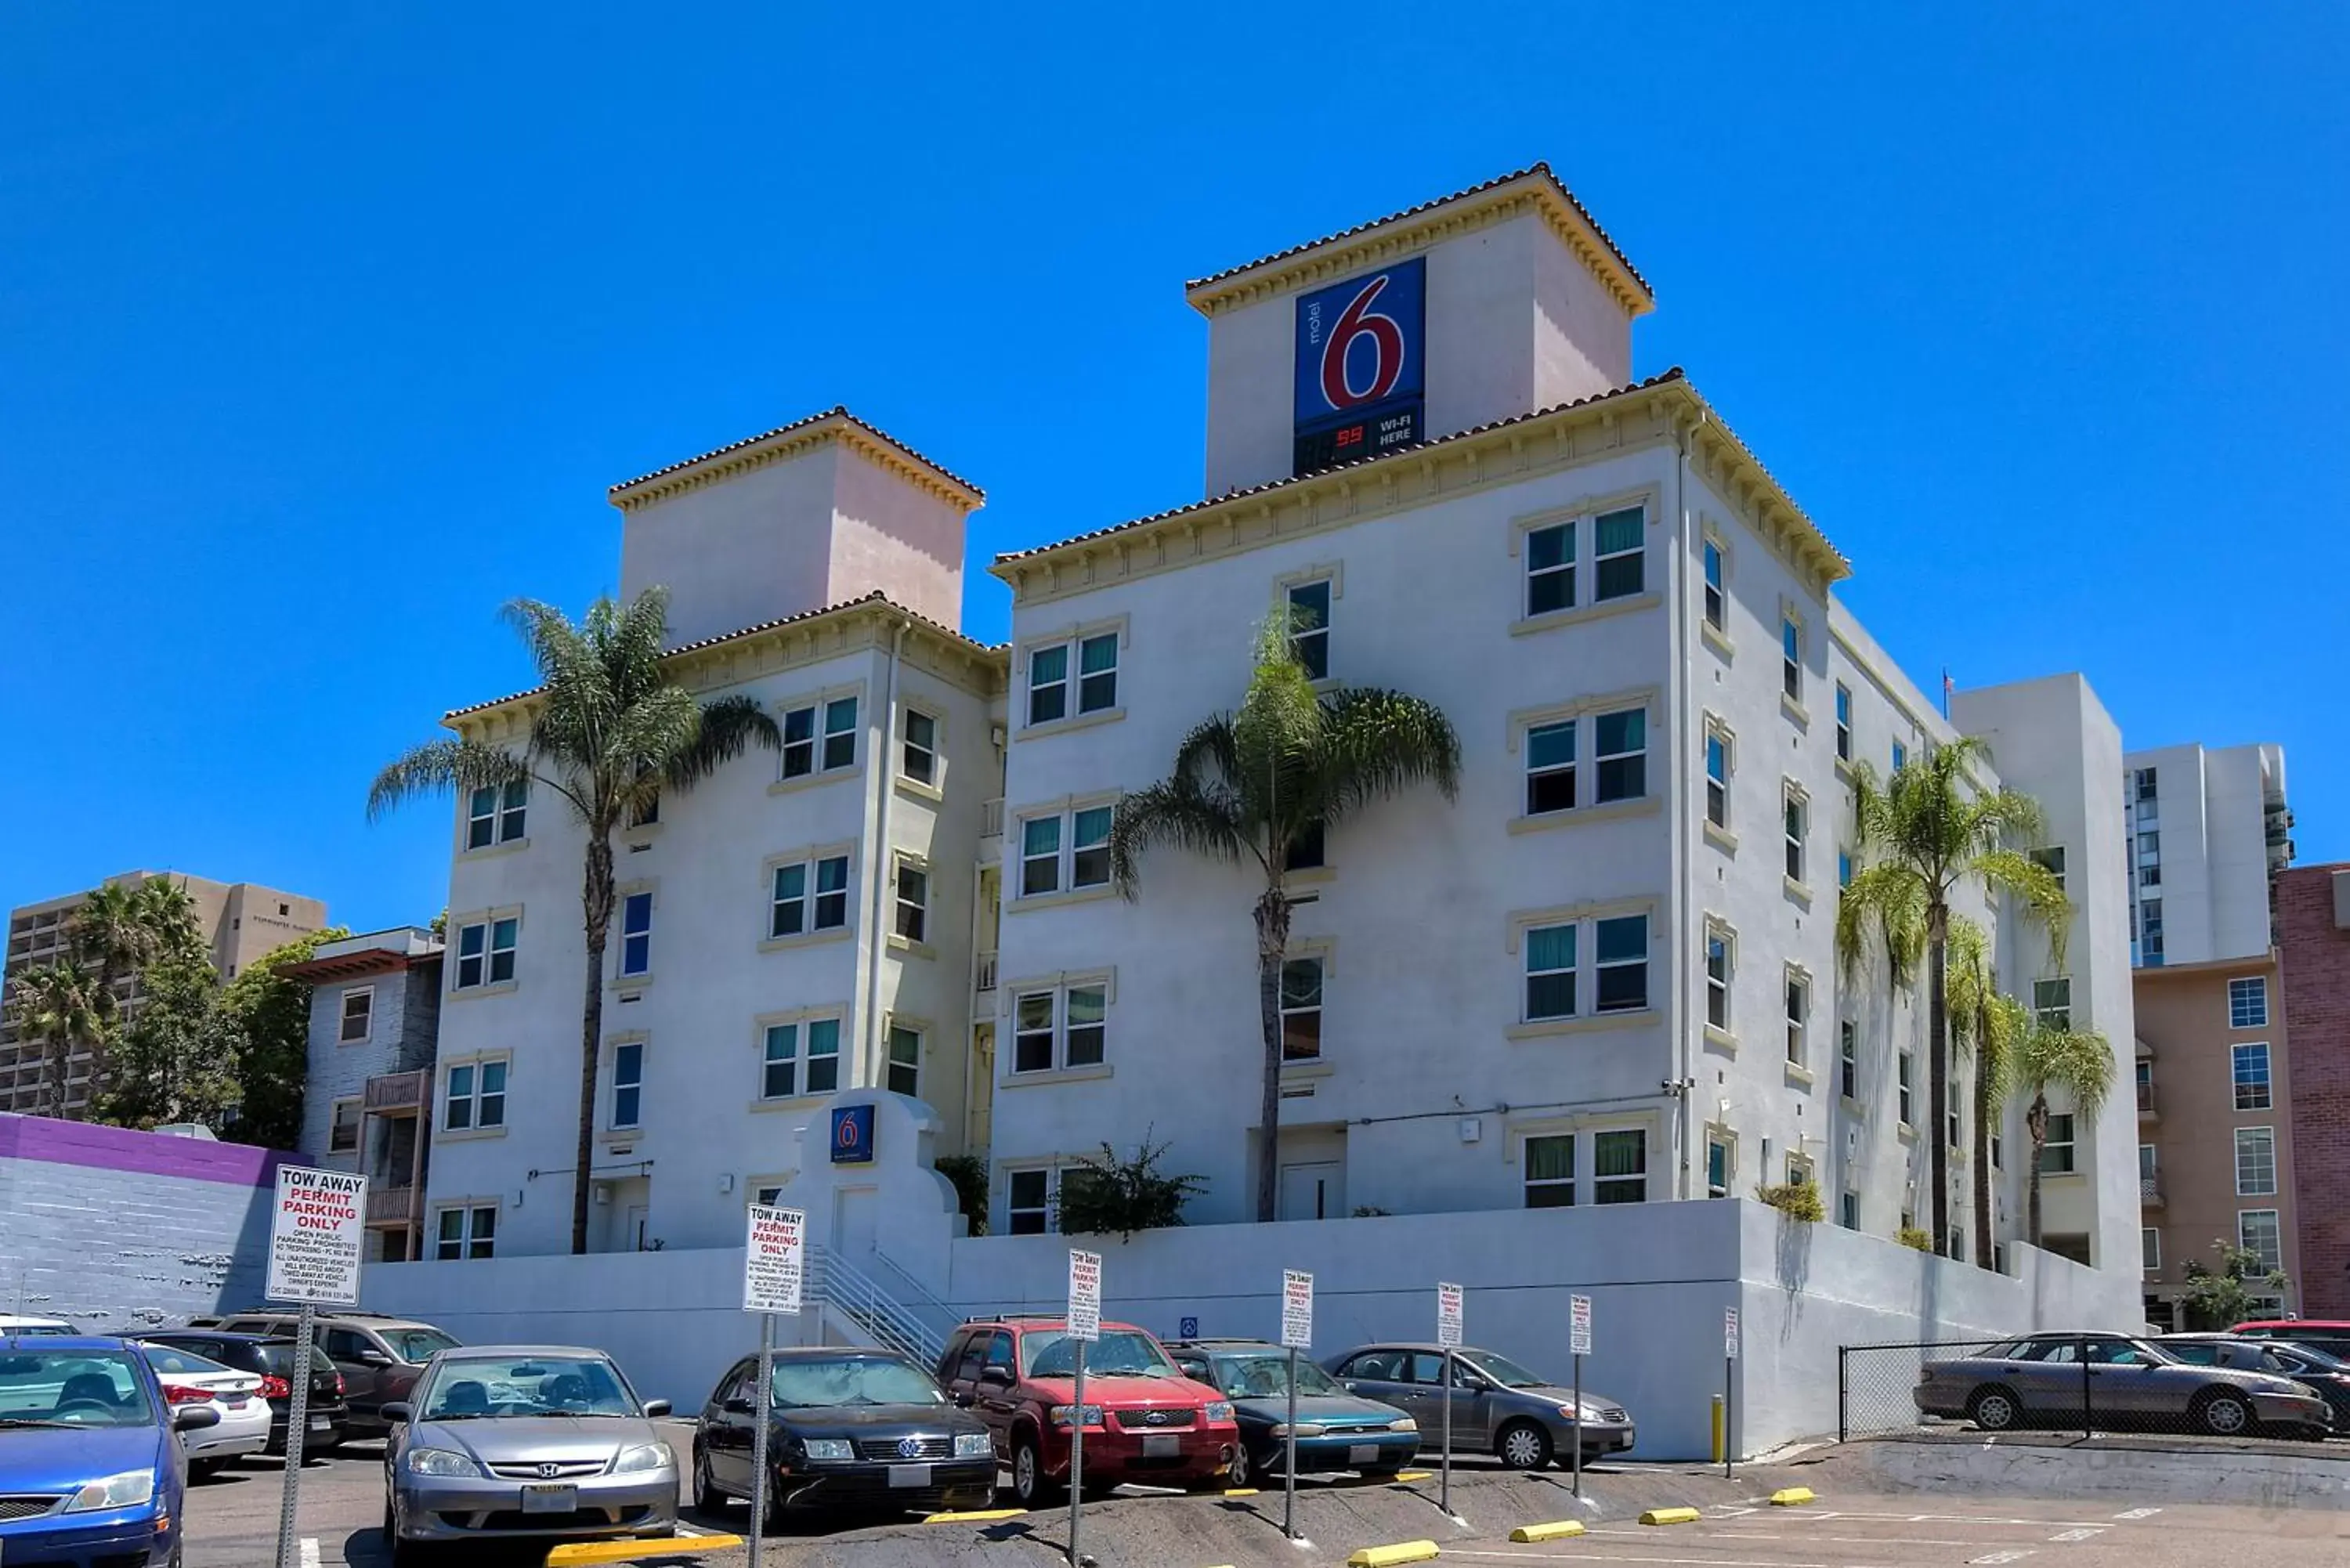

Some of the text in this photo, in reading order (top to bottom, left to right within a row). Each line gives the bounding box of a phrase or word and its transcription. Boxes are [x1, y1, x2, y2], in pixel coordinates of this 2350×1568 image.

[1308, 274, 1405, 410] motel 6
[1380, 414, 1411, 432] WI-FI
[1379, 428, 1411, 446] HERE
[838, 1111, 857, 1147] 6
[282, 1170, 363, 1193] TOW AWAY
[291, 1188, 352, 1205] PERMIT
[283, 1201, 356, 1219] PARKING
[751, 1208, 802, 1225] TOW AWAY
[297, 1216, 341, 1230] ONLY
[756, 1222, 796, 1235] PERMIT
[277, 1235, 357, 1250] PARKING PROHIBITED
[752, 1232, 798, 1246] PARKING
[761, 1245, 789, 1255] ONLY
